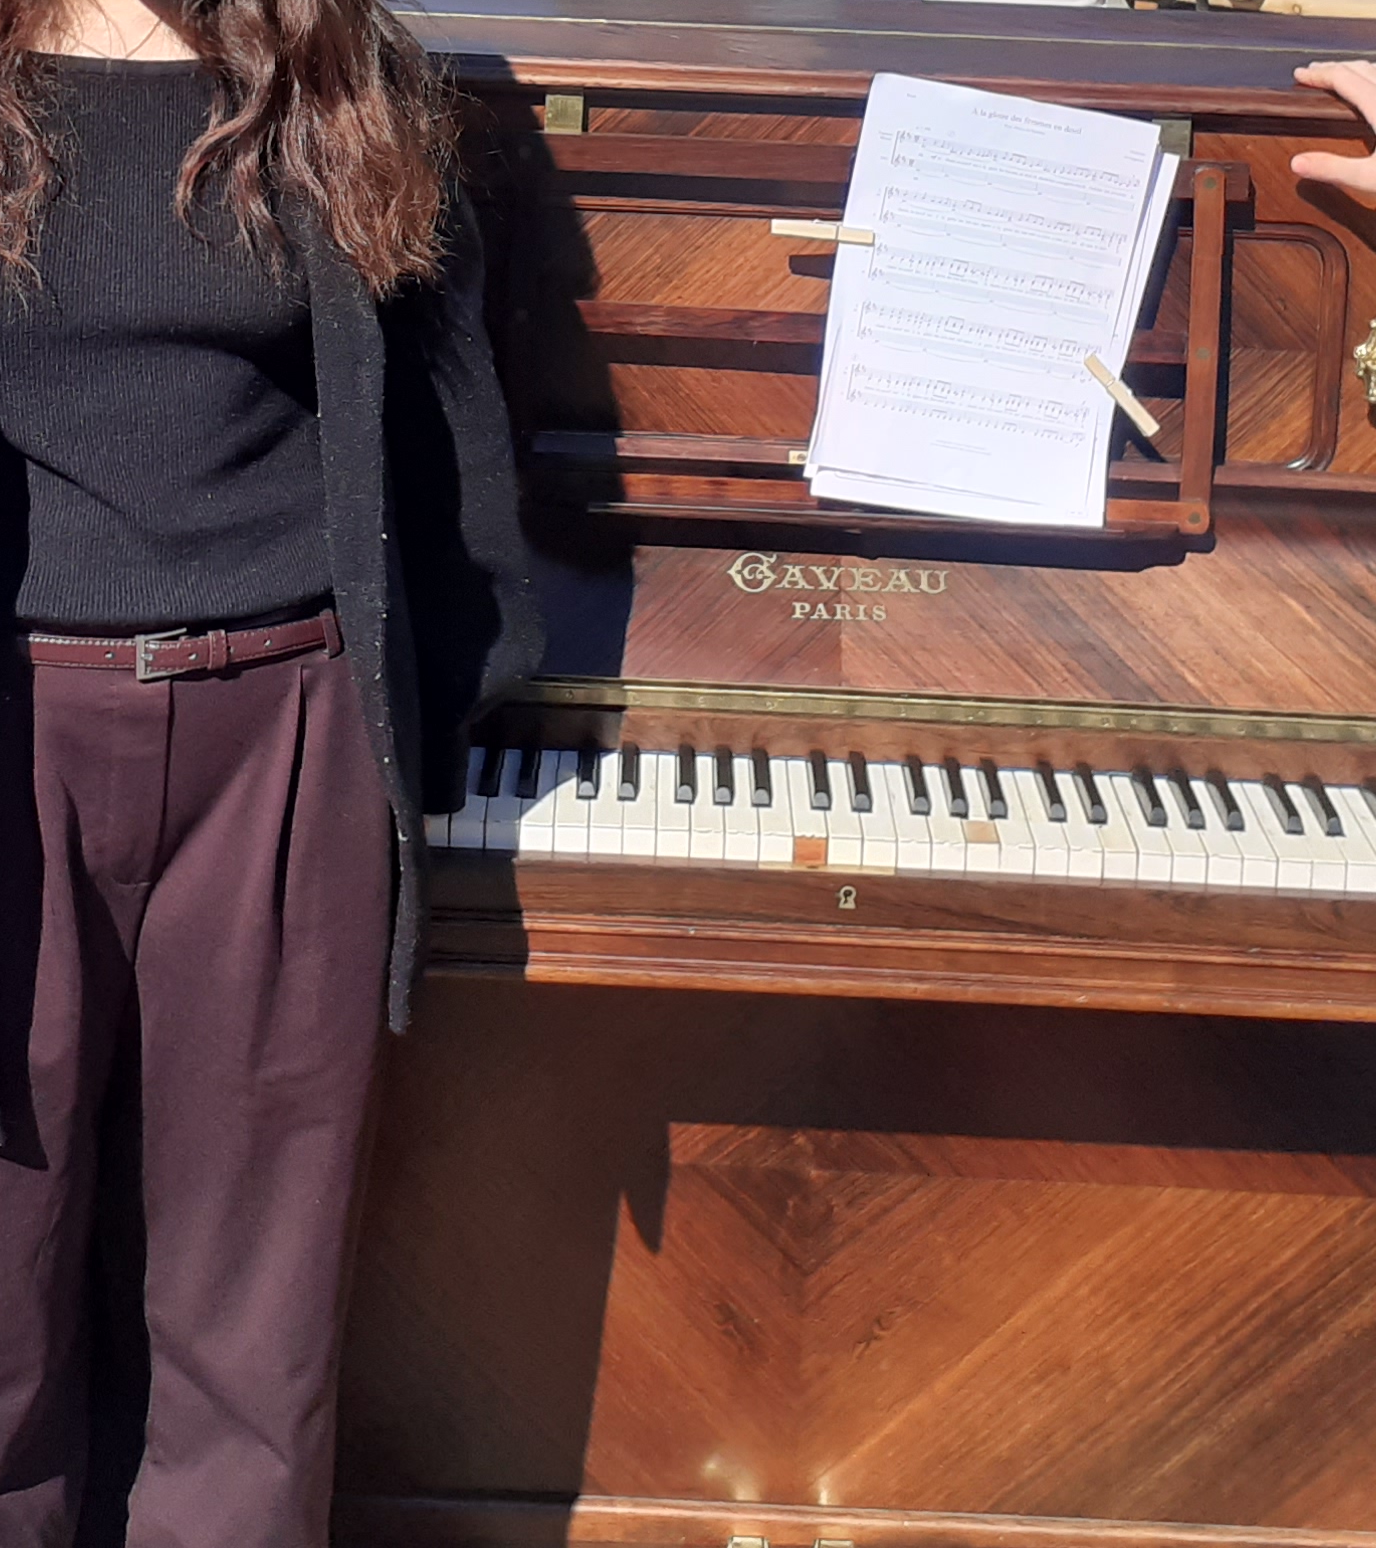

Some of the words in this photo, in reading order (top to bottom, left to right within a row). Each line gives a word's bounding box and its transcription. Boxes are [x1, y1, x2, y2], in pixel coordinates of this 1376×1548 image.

[1010, 114, 1023, 123] des
[727, 552, 950, 594] GAVEAU
[791, 602, 887, 621] PARIS
